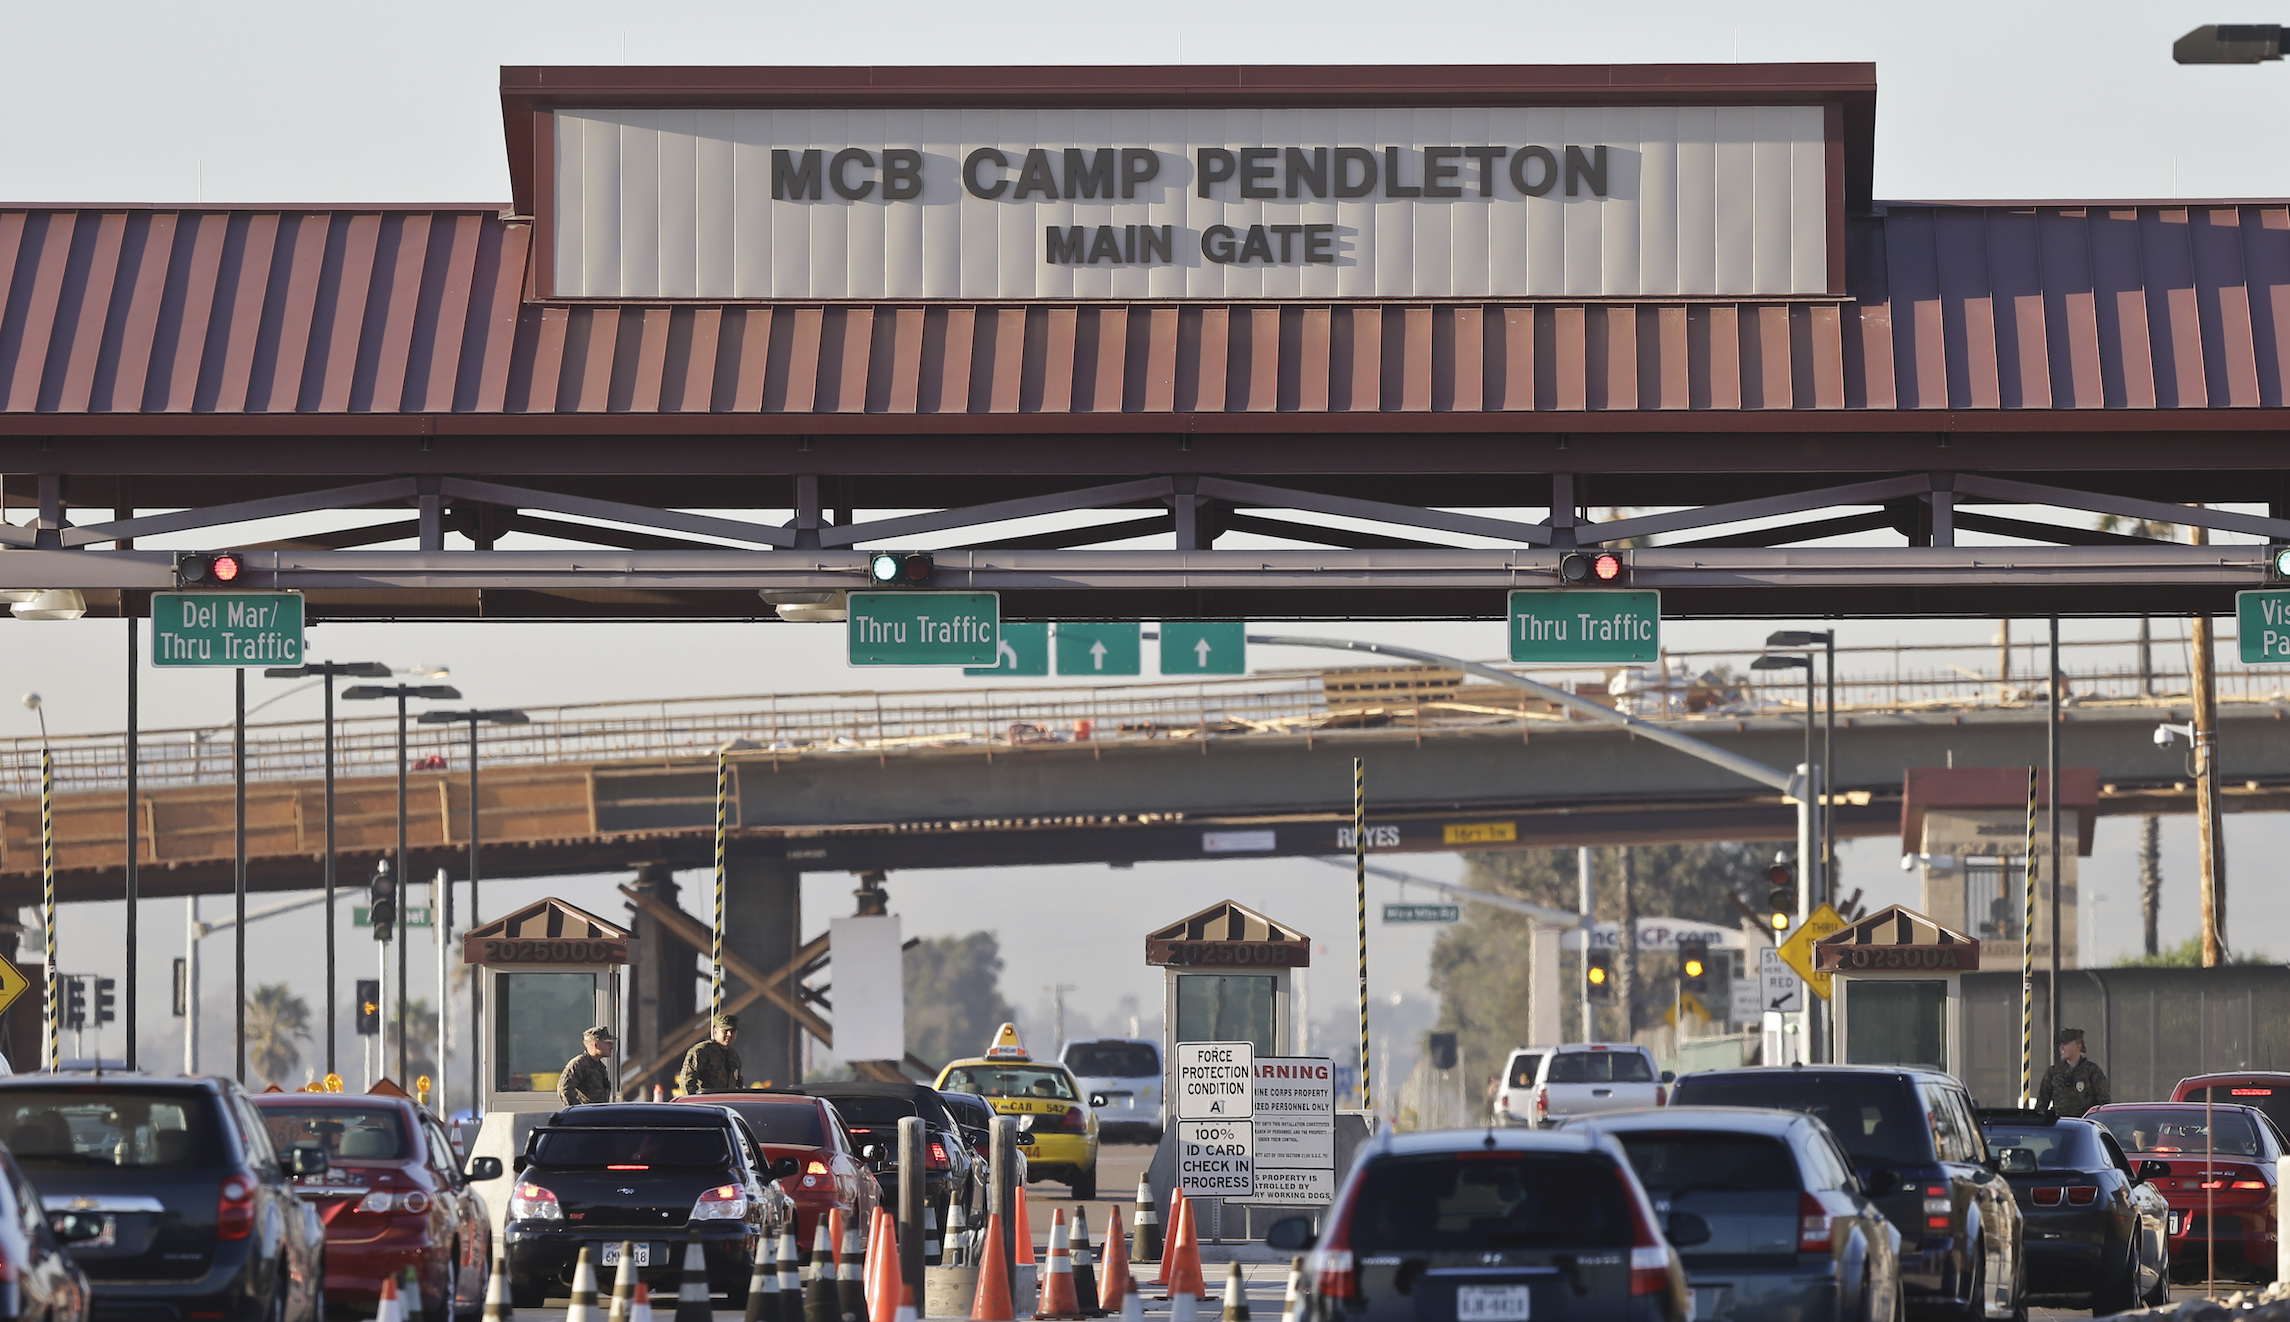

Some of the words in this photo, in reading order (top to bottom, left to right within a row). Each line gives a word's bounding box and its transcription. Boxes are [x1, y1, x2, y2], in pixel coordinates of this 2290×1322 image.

[771, 149, 923, 201] MCB
[963, 148, 1160, 200] CAMP
[1198, 145, 1608, 199] PENDLETON
[1046, 226, 1173, 264] MAIN
[1201, 224, 1334, 264] GATE
[182, 601, 217, 629] Del
[227, 601, 280, 629] Mar/
[856, 616, 907, 644] Thru
[917, 616, 991, 644] Traffic
[1517, 614, 1568, 641] Thru
[1578, 614, 1652, 642] Traffic
[161, 633, 211, 660] Thru
[222, 633, 296, 660] Traffic
[484, 941, 608, 962] 202500C
[1167, 942, 1289, 964] 202500B
[1835, 947, 1959, 969] 202500A
[1769, 977, 1794, 988] RED
[1198, 1050, 1233, 1063] FORCE
[1182, 1066, 1249, 1079] PROTECTION
[1254, 1065, 1329, 1080] ARNING
[1188, 1082, 1245, 1095] CONDITION
[1270, 1088, 1292, 1097] CORPS
[1294, 1088, 1329, 1097] PROPERTY
[1010, 1102, 1032, 1111] CAB
[1046, 1103, 1065, 1113] 542
[1209, 1101, 1221, 1113] A
[1271, 1103, 1310, 1111] PERSONNEL
[1312, 1103, 1329, 1111] ONLY
[1195, 1128, 1235, 1140] 100%
[1186, 1145, 1200, 1156] ID
[1205, 1145, 1246, 1156] CARD
[1183, 1161, 1230, 1172] CHECK
[1236, 1161, 1249, 1172] IN
[1183, 1177, 1249, 1188] PROGRESS
[1263, 1174, 1306, 1182] PROPERTY
